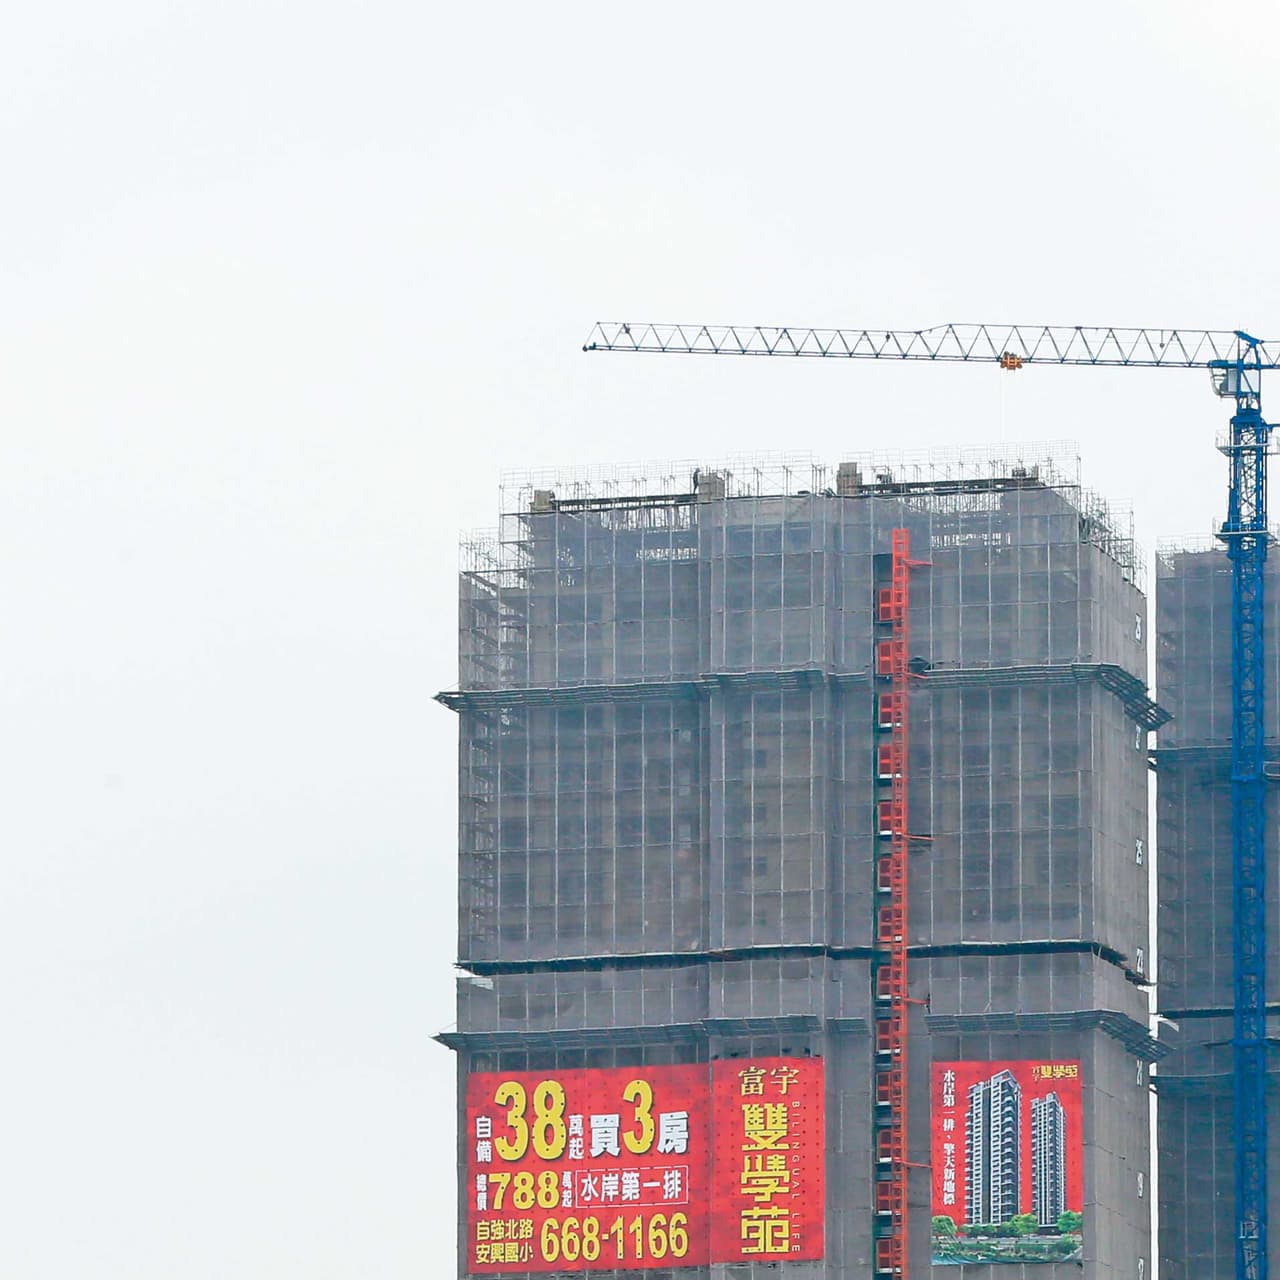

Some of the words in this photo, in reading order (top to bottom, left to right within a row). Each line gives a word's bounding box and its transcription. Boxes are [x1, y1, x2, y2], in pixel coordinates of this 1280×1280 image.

[738, 1066, 800, 1096] 富宇
[580, 1170, 681, 1202] 水岸第一排
[476, 1219, 534, 1240] 自強北路
[540, 1212, 688, 1262] 668-1166
[792, 1212, 800, 1252] LIFE
[476, 1242, 534, 1264] 安興國小
